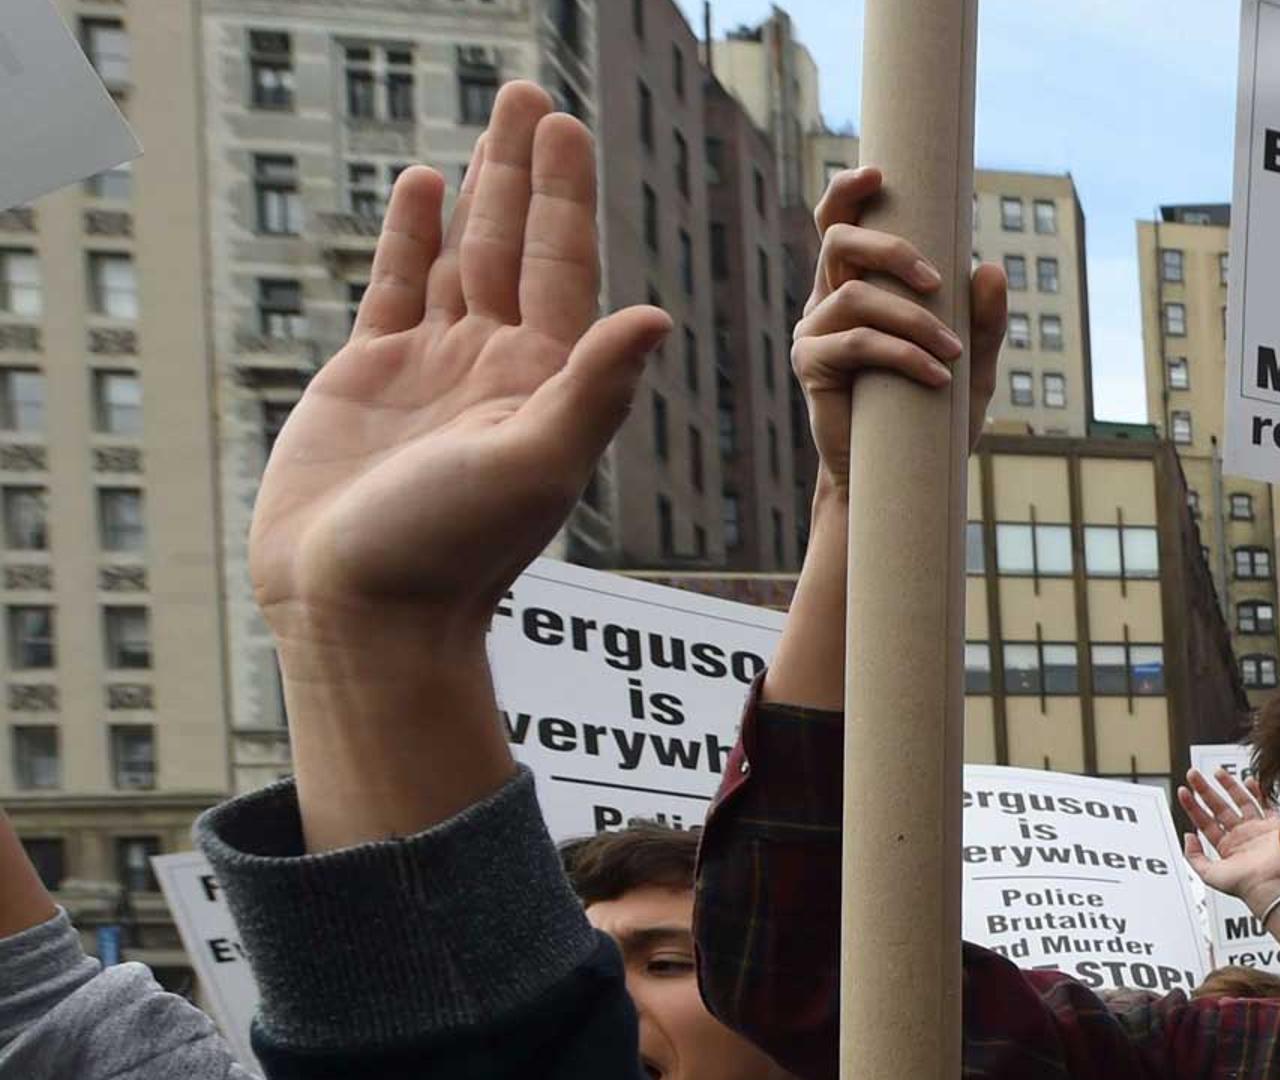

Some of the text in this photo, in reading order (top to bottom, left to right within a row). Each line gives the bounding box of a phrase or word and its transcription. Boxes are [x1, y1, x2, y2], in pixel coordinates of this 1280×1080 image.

[487, 588, 767, 685] erguso
[627, 677, 686, 726] is
[500, 709, 733, 775] verywh
[1018, 817, 1059, 841] is
[963, 843, 1169, 876] erywhere
[1001, 888, 1105, 908] Police
[986, 911, 1128, 935] Brutality
[1224, 916, 1268, 941] MU
[1041, 935, 1155, 956] Murder
